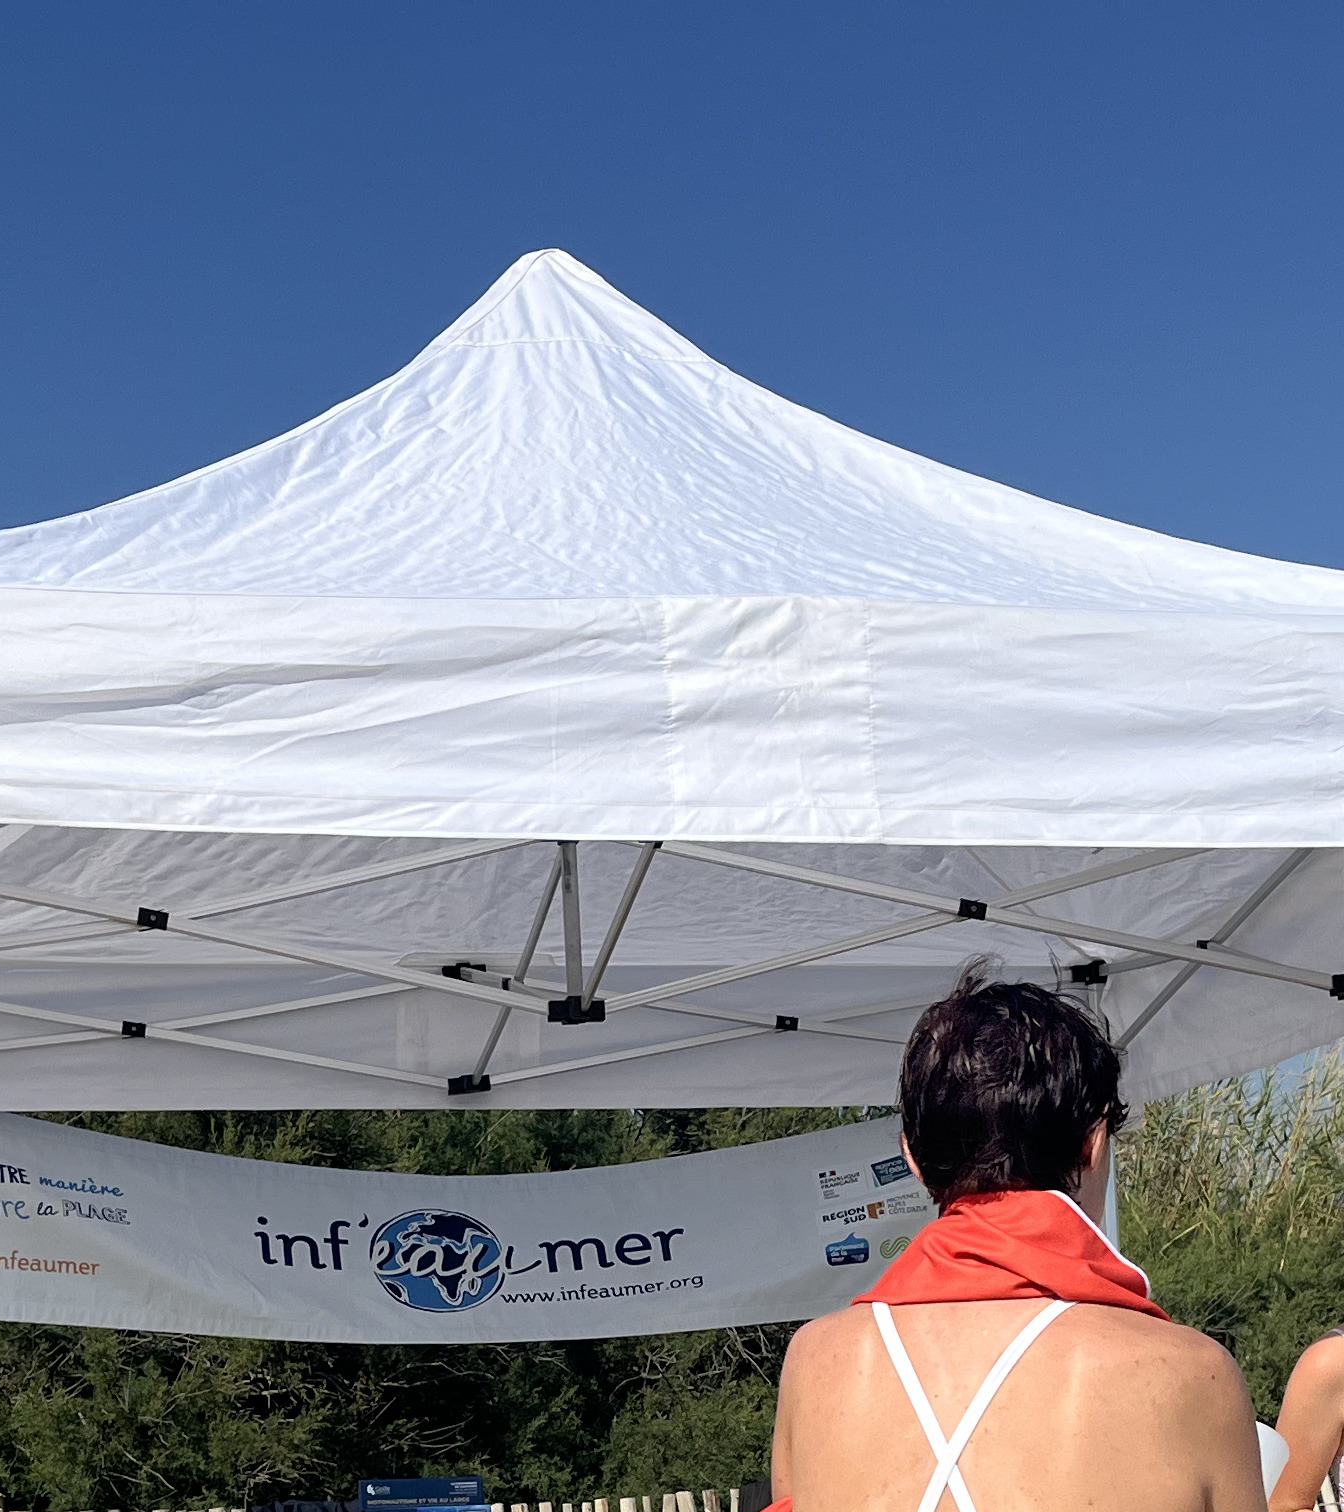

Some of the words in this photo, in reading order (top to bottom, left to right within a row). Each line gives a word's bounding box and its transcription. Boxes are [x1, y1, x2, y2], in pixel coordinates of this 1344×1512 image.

[39, 1175, 124, 1197] manière
[37, 1202, 58, 1216] la
[62, 1199, 131, 1225] PLAGE
[843, 1213, 867, 1225] SUD
[500, 1273, 704, 1304] www.infeaumer.org
